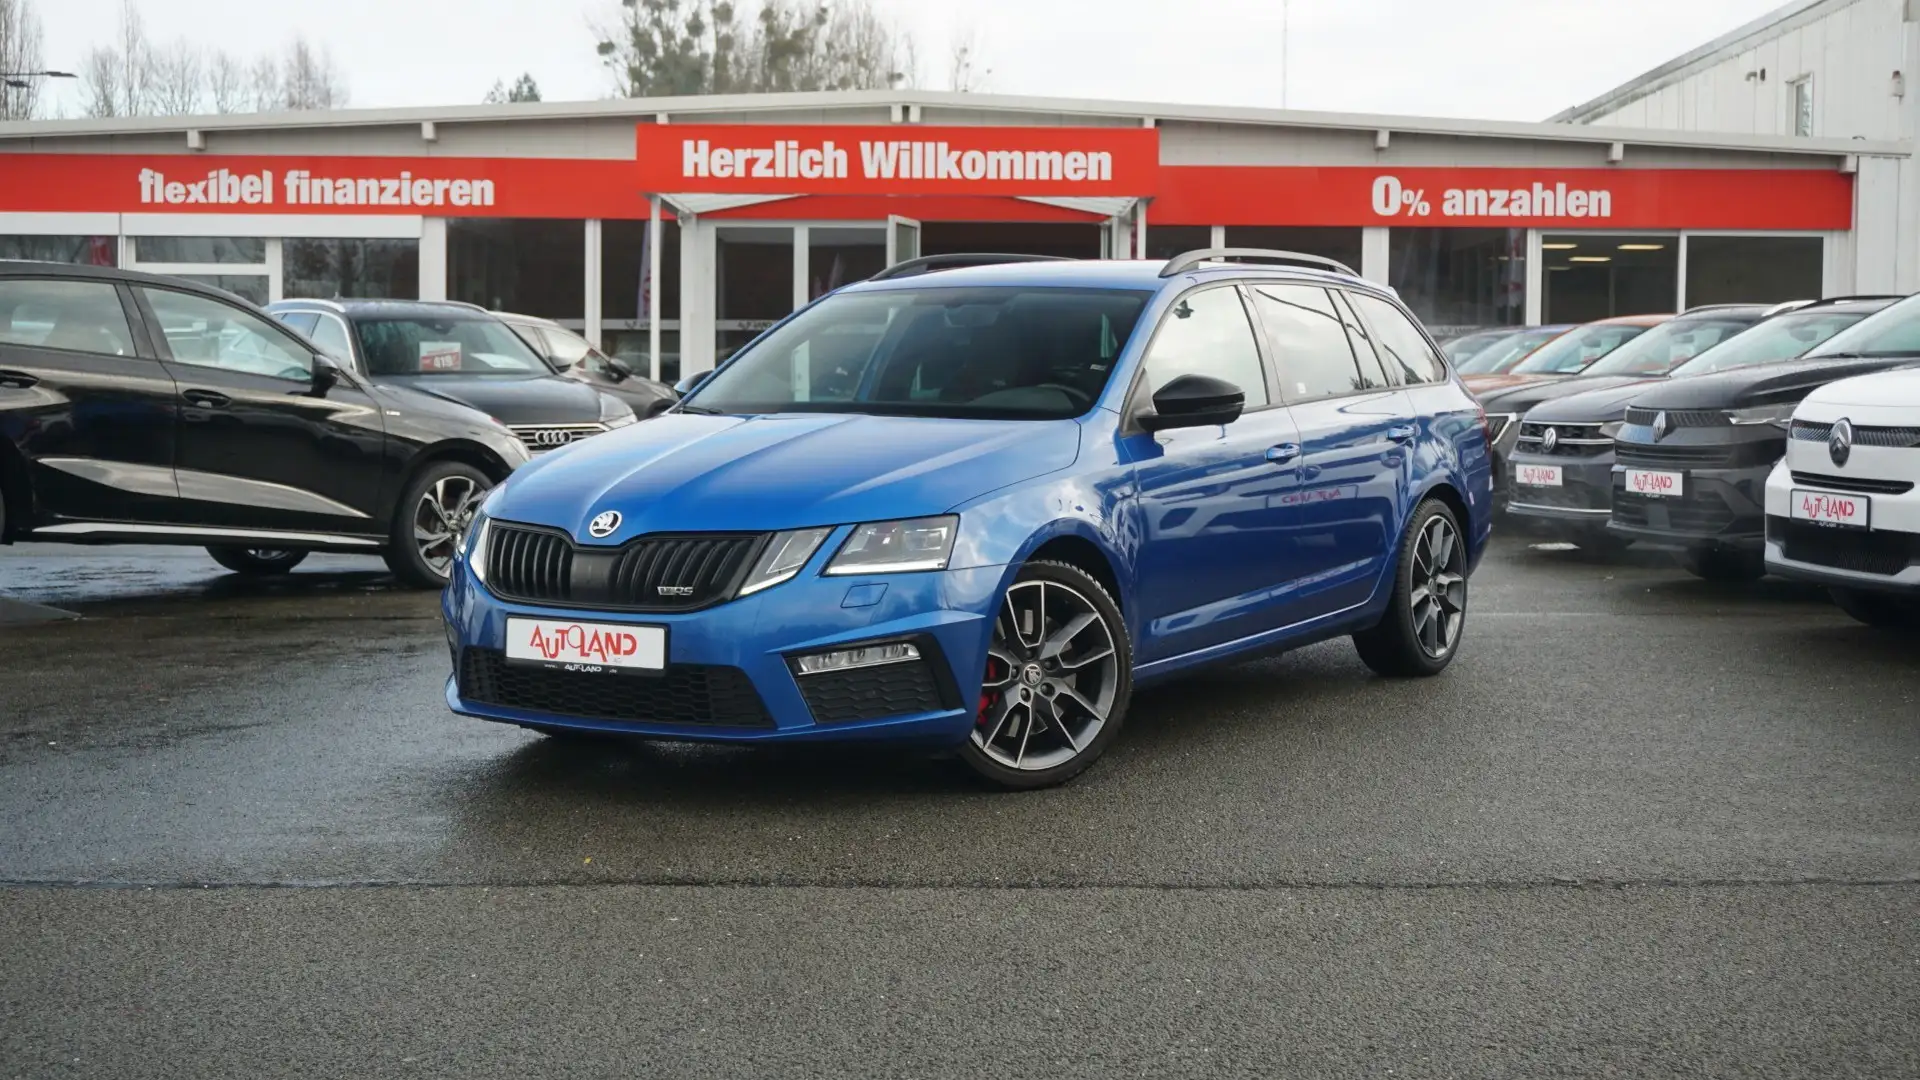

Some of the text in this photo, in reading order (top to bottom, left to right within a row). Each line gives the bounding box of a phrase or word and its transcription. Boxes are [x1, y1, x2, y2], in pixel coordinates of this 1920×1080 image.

[682, 140, 1112, 181] Herzlich Willkommen
[138, 168, 494, 206] flexibel finanzieren
[1372, 175, 1611, 217] 0% anzahlen
[1803, 494, 1855, 521] AUTOLAND
[530, 624, 638, 663] AUTOLAND
[564, 663, 603, 673] AUTOLAND
